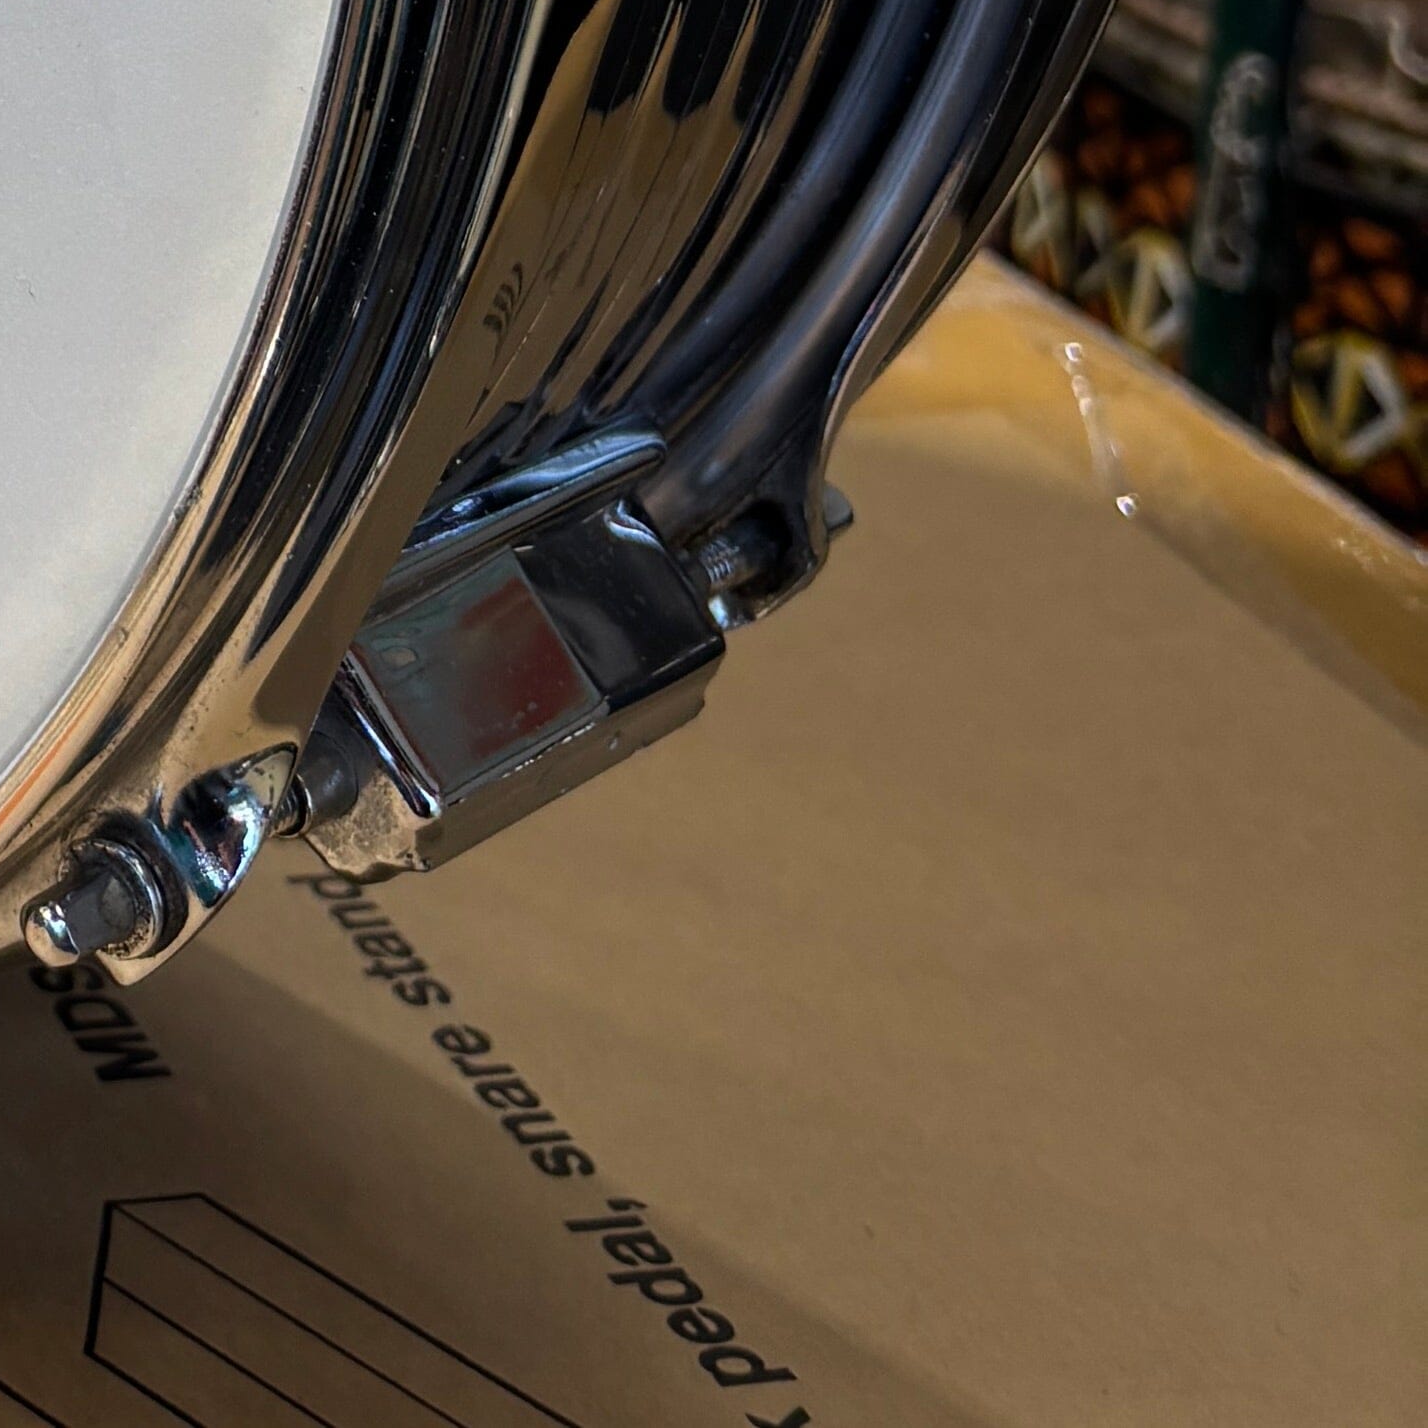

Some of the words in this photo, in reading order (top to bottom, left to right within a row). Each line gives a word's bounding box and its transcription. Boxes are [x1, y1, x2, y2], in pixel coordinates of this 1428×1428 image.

[287, 874, 452, 1006] stand
[432, 1024, 595, 1177] snare
[563, 1197, 797, 1387] pedal,
